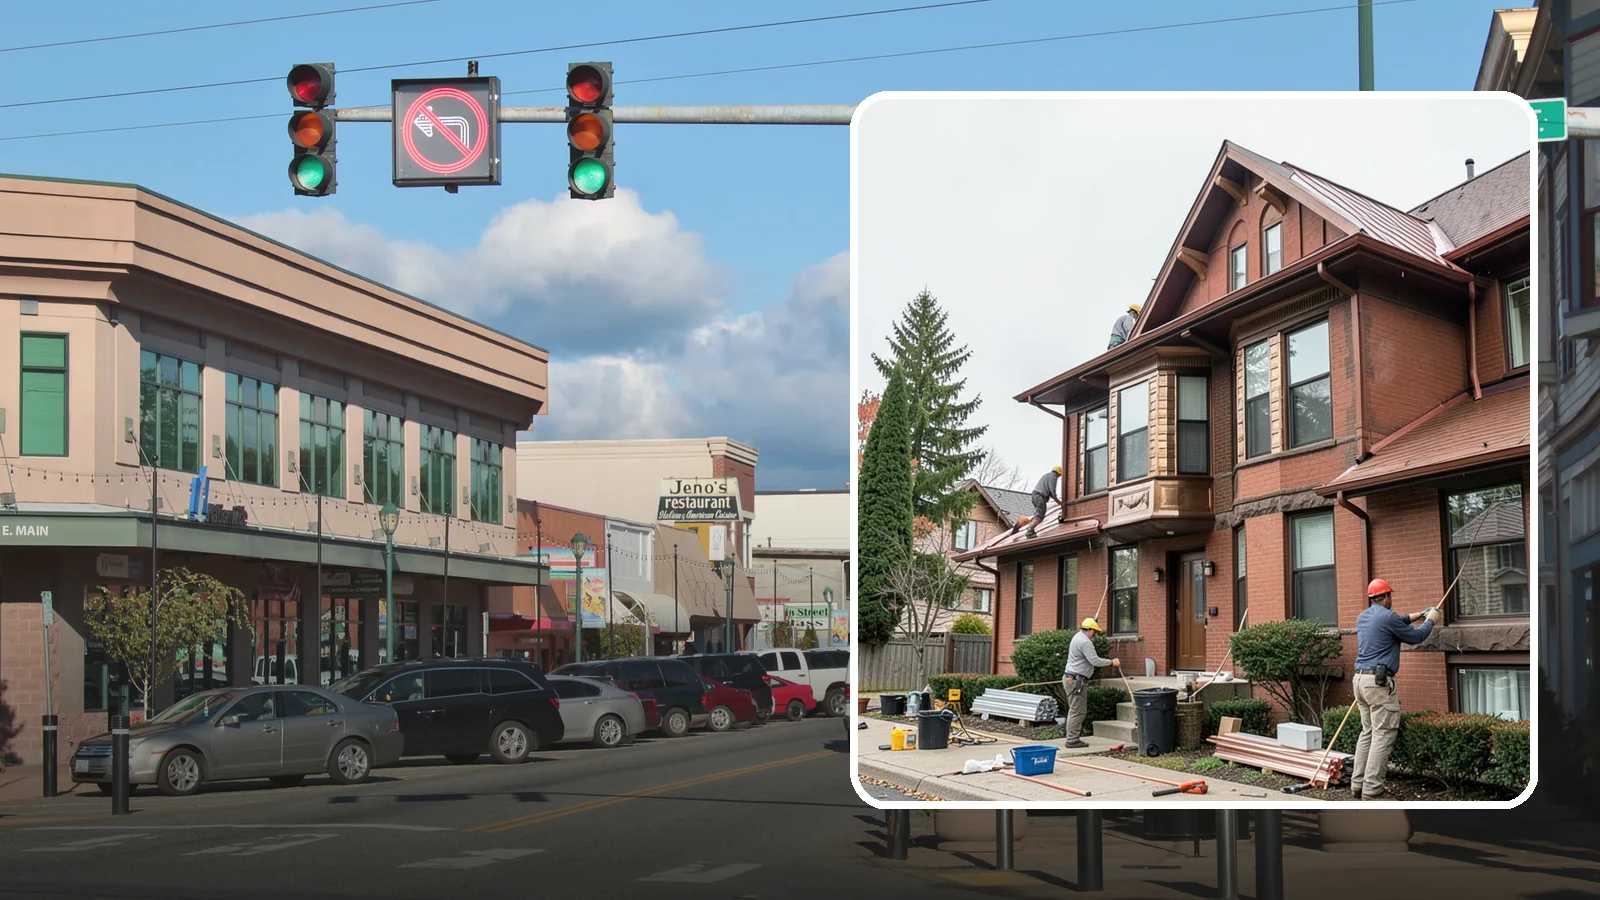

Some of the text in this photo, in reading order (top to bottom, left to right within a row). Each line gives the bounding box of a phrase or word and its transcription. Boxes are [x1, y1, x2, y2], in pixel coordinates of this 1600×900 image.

[669, 479, 728, 494] Jeno's
[665, 496, 732, 509] restaurant
[658, 509, 682, 520] Italian
[686, 509, 715, 519] American
[714, 509, 737, 519] Cuisine
[2, 525, 49, 536] E. MAIN
[797, 607, 828, 617] Street
